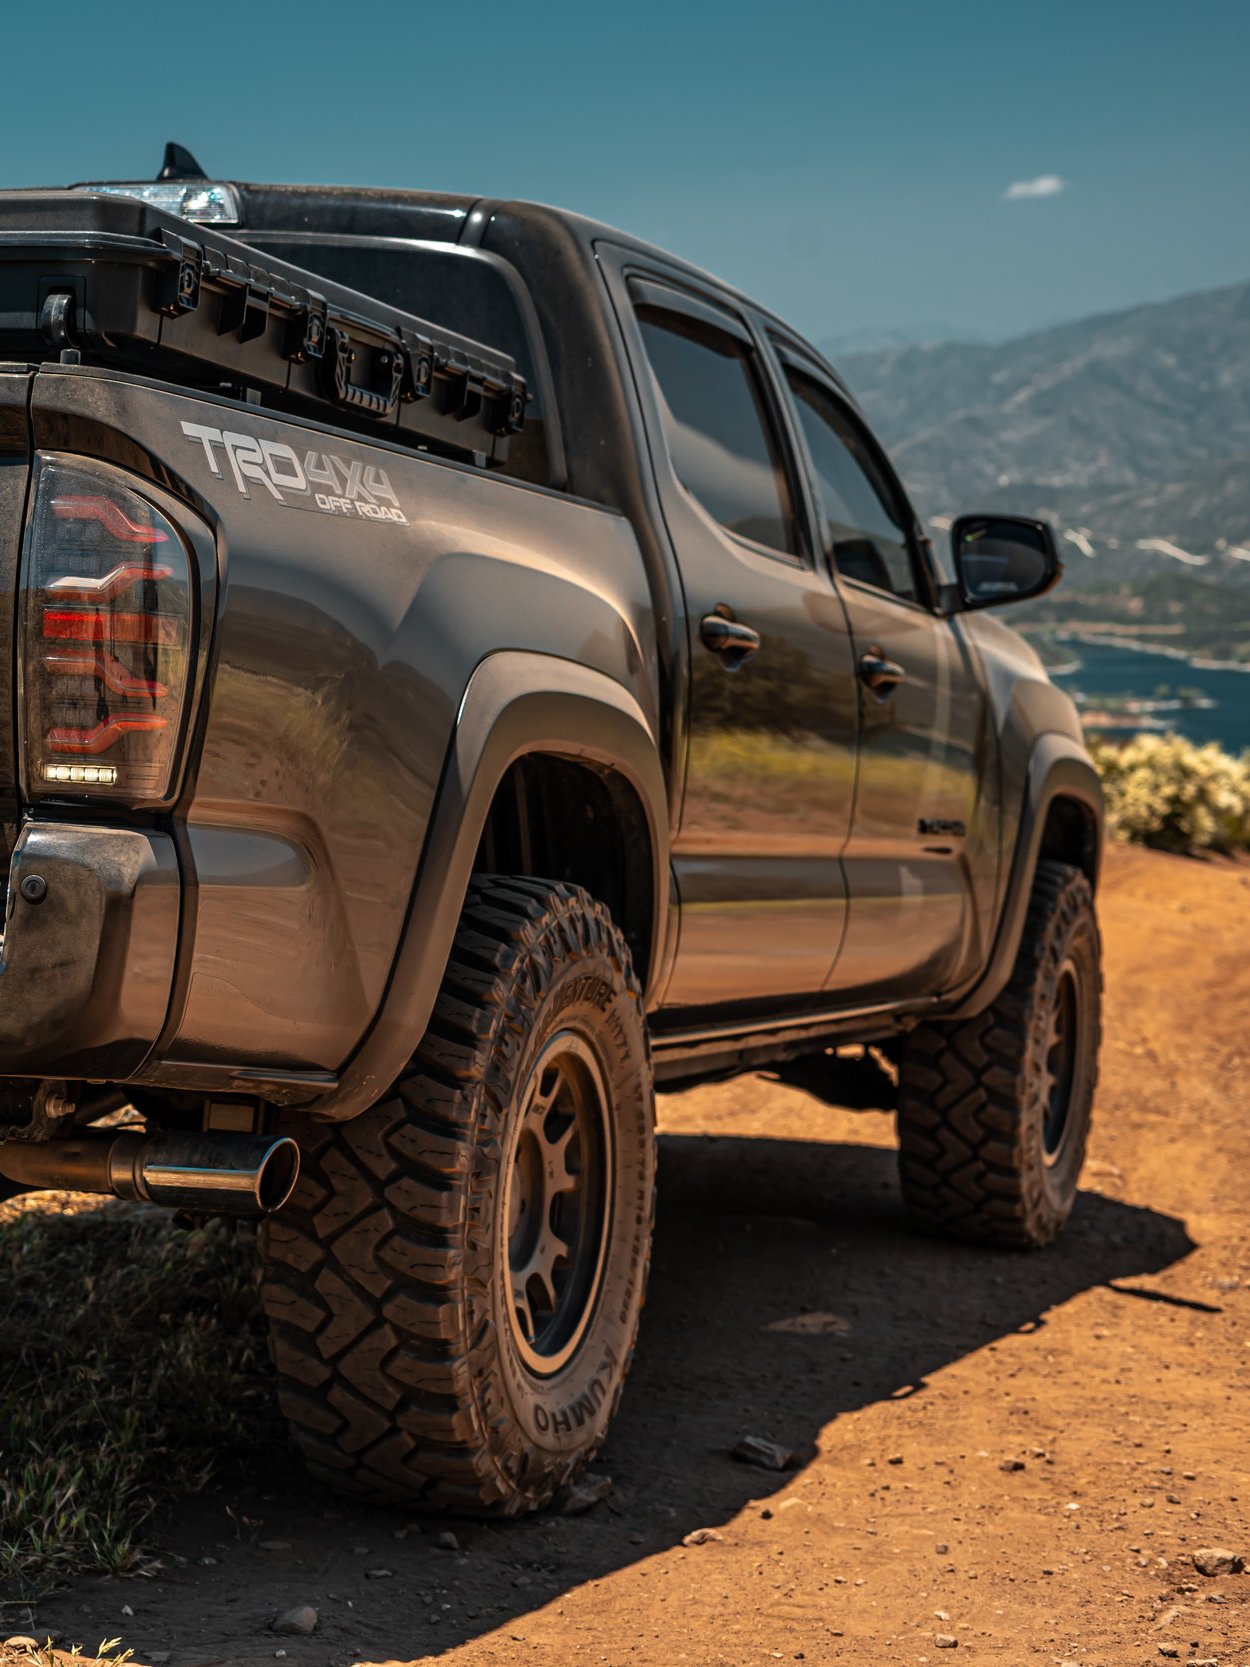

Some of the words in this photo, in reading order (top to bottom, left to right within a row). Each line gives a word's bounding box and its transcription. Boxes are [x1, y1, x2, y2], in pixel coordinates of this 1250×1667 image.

[180, 420, 308, 502] TRD
[315, 493, 352, 513] OFF
[354, 501, 408, 524] ROAD
[533, 1342, 619, 1434] KUMHO
